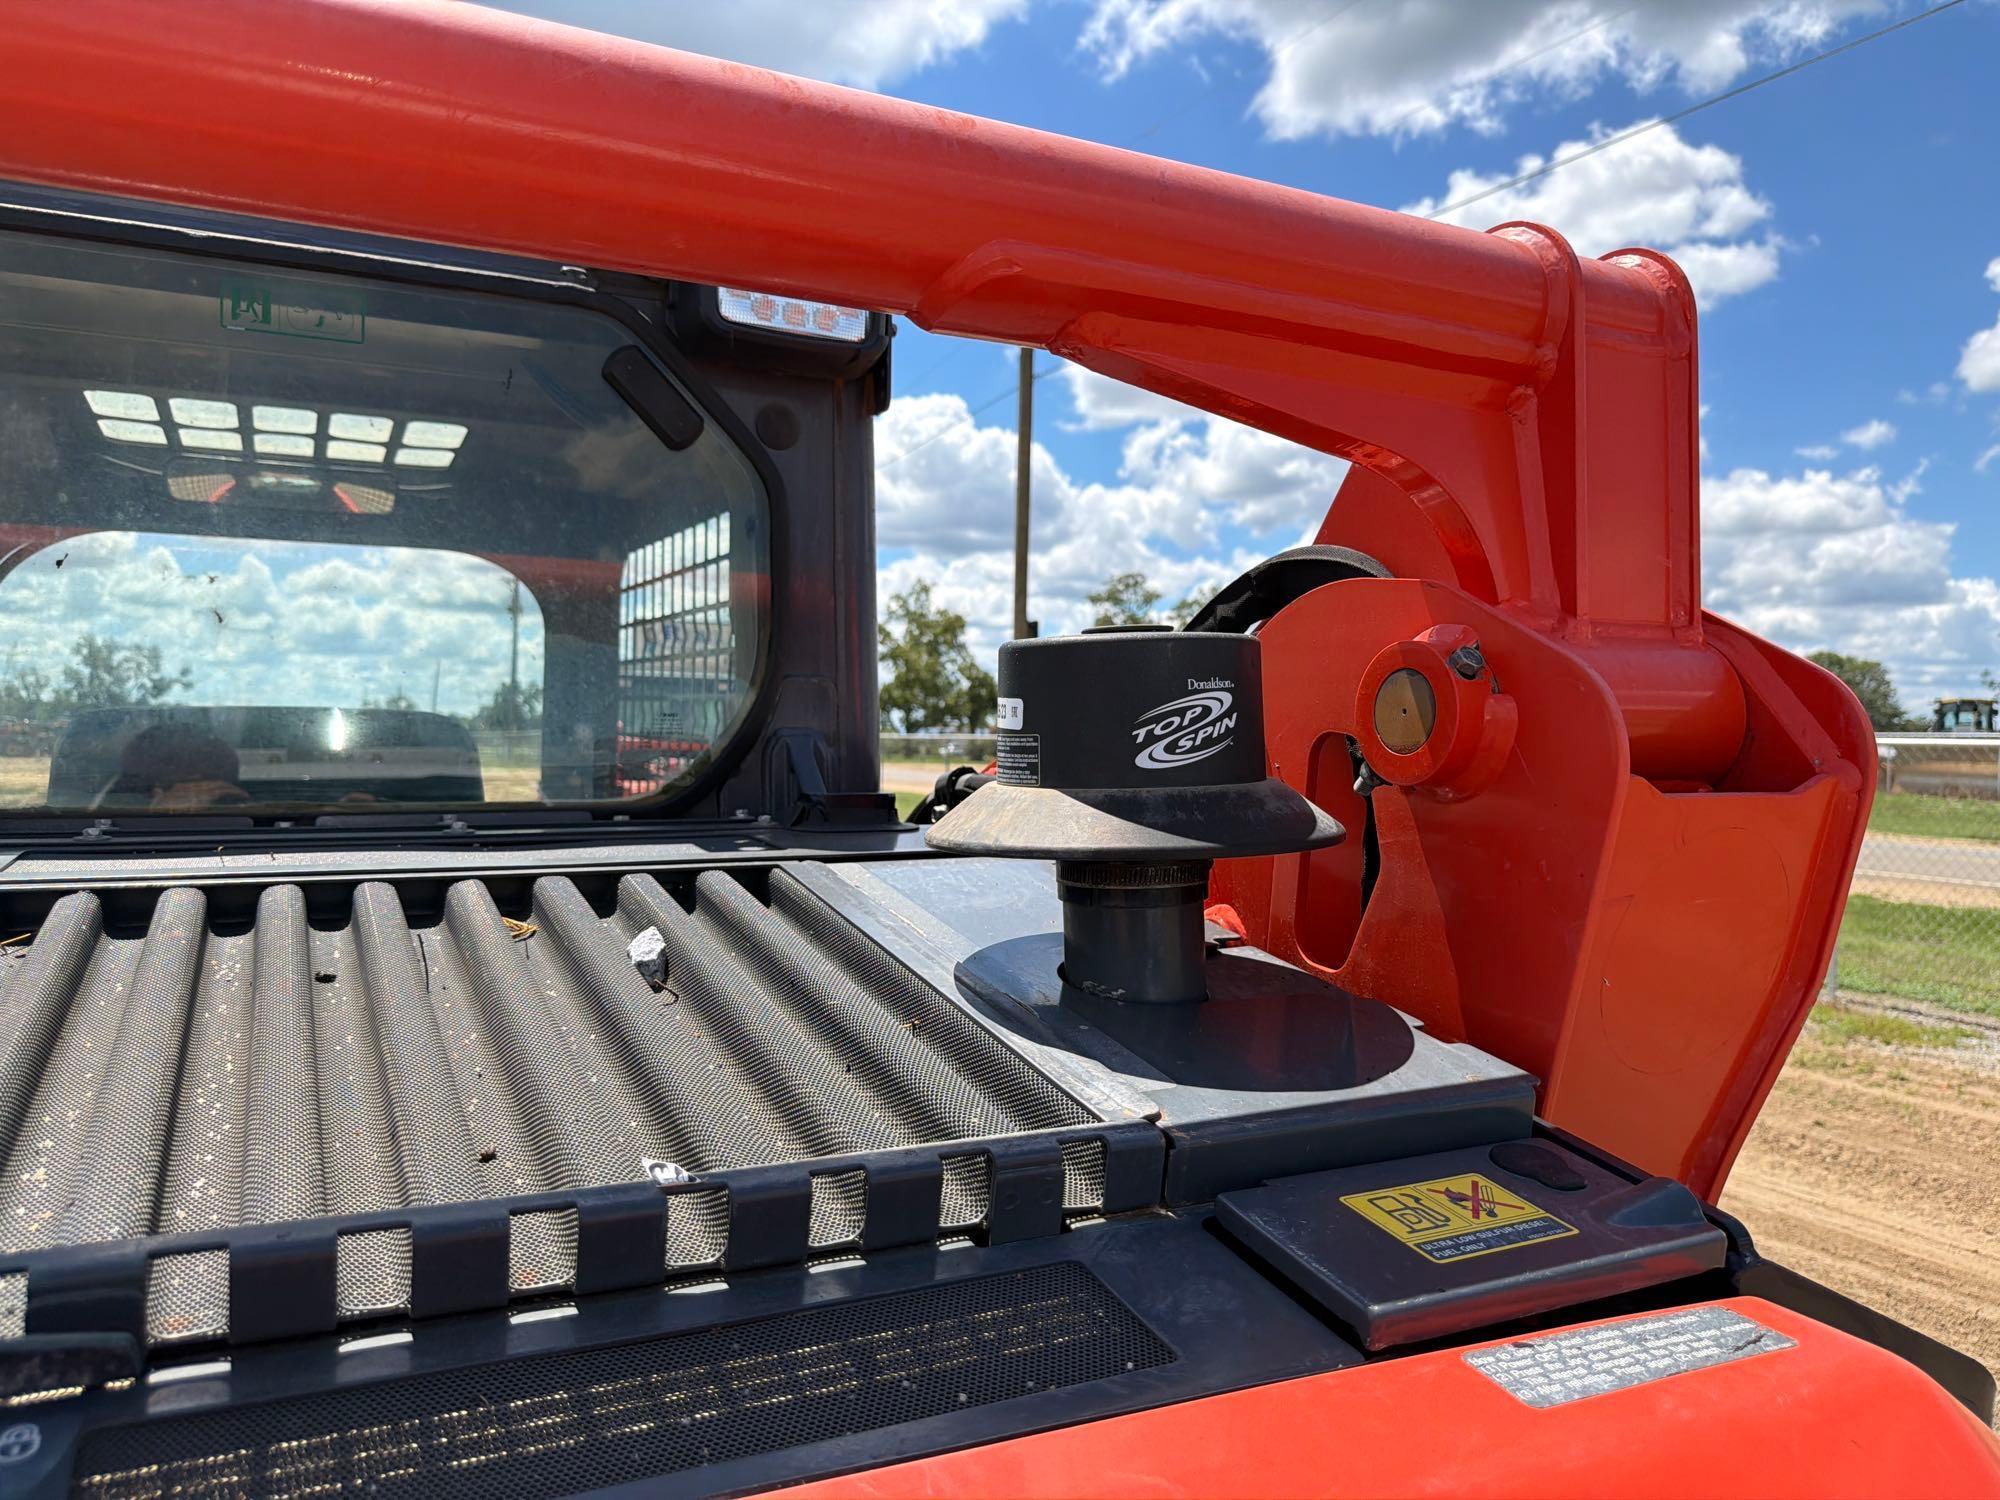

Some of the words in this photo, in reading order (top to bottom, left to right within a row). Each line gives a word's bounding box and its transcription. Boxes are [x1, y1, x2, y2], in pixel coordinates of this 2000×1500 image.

[1187, 677, 1232, 690] Donaldson
[1132, 706, 1203, 744] TOP
[1175, 712, 1237, 753] SPIN
[1420, 1239, 1455, 1251] ULTRA
[1455, 1233, 1476, 1243] LOW
[1476, 1225, 1514, 1238] SULFUR
[1513, 1219, 1549, 1231] DIESEL
[1433, 1248, 1461, 1258] FUEL
[1459, 1241, 1487, 1252] ONLY
[1467, 1356, 1497, 1365] How
[1511, 1348, 1536, 1356] use
[1533, 1342, 1559, 1351] fuel
[1555, 1336, 1586, 1346] level
[1478, 1364, 1502, 1374] (1)
[1496, 1358, 1536, 1369] Power
[1532, 1351, 1562, 1361] OFF
[1521, 1376, 1549, 1385] The
[1546, 1366, 1588, 1379] interval
[1590, 1356, 1635, 1369] changes
[1647, 1348, 1670, 1356] the
[1666, 1343, 1691, 1352] fuel
[1490, 1372, 1514, 1382] (2)
[1509, 1366, 1545, 1377] Press
[1542, 1362, 1565, 1370] the
[1562, 1357, 1590, 1365] Jog
[1585, 1351, 1609, 1360] dial
[1513, 1389, 1539, 1400] (3)
[1533, 1384, 1566, 1395] After
[1610, 1364, 1646, 1375] Press
[1644, 1358, 1676, 1368] again
